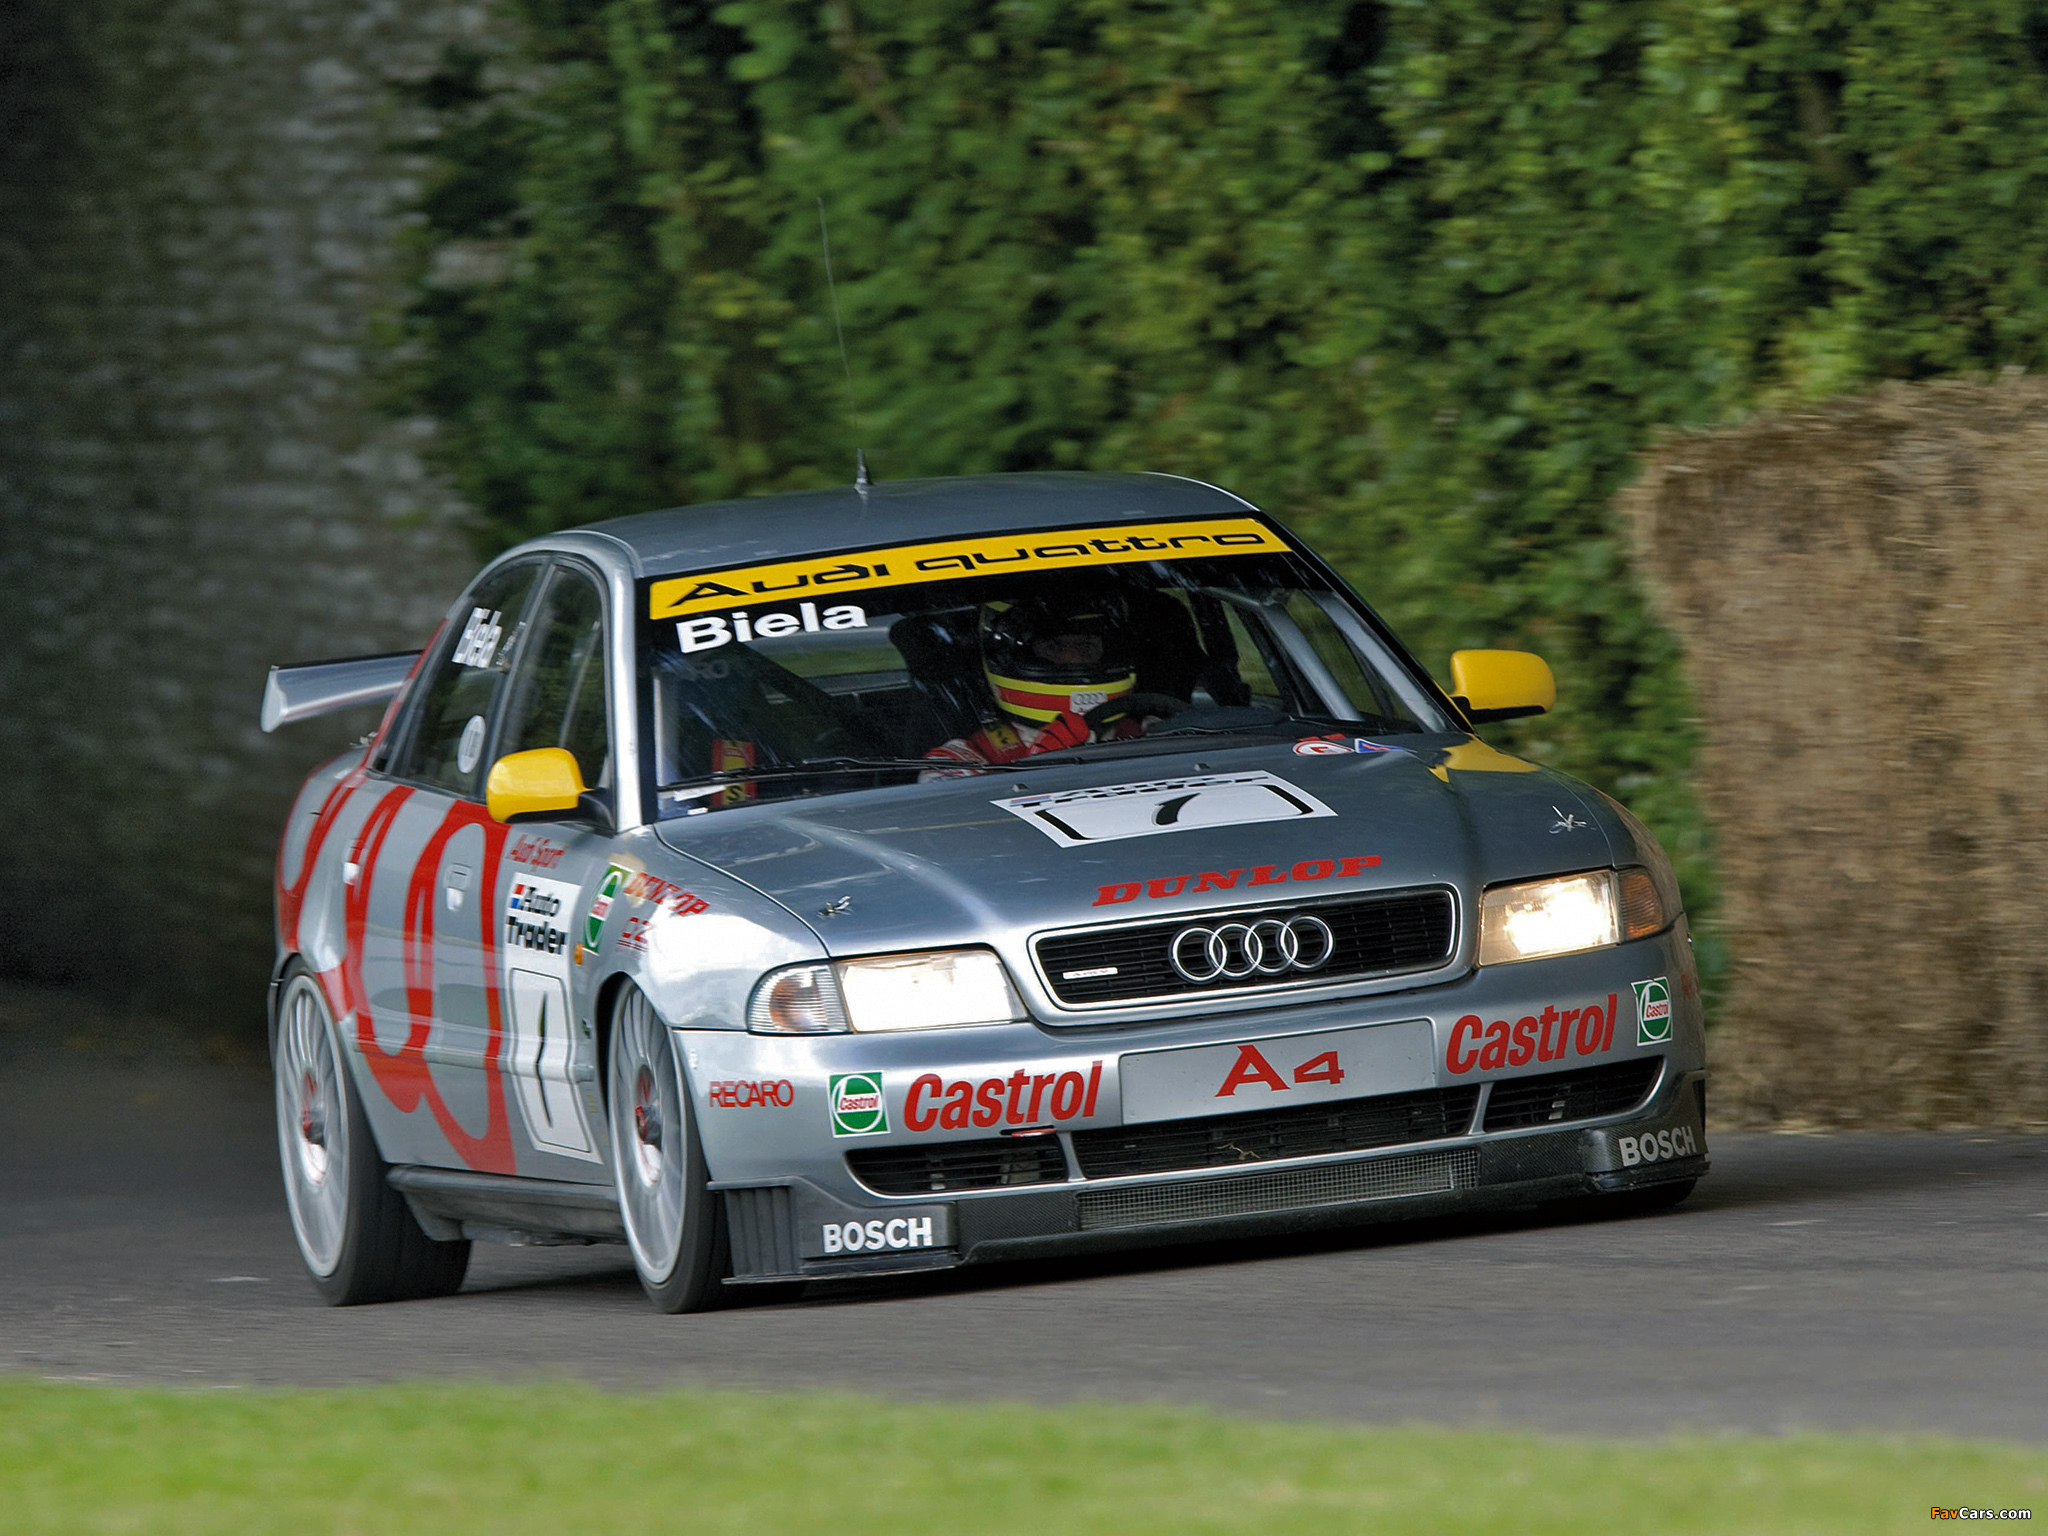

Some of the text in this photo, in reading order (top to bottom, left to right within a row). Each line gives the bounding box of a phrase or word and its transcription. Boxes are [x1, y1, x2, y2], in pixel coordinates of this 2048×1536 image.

[666, 533, 1265, 608] Audi quattro
[675, 602, 869, 654] Biela
[1091, 855, 1382, 907] DUNLOP
[1445, 993, 1618, 1075] Castrol
[1646, 1001, 1669, 1018] Castrol
[708, 1079, 794, 1108] RECARO
[904, 1060, 1103, 1132] Castrol
[1214, 1044, 1345, 1097] A4
[838, 1093, 880, 1112] Castrol
[1619, 1126, 1697, 1167] BOSCH
[822, 1216, 933, 1254] BOSCH
